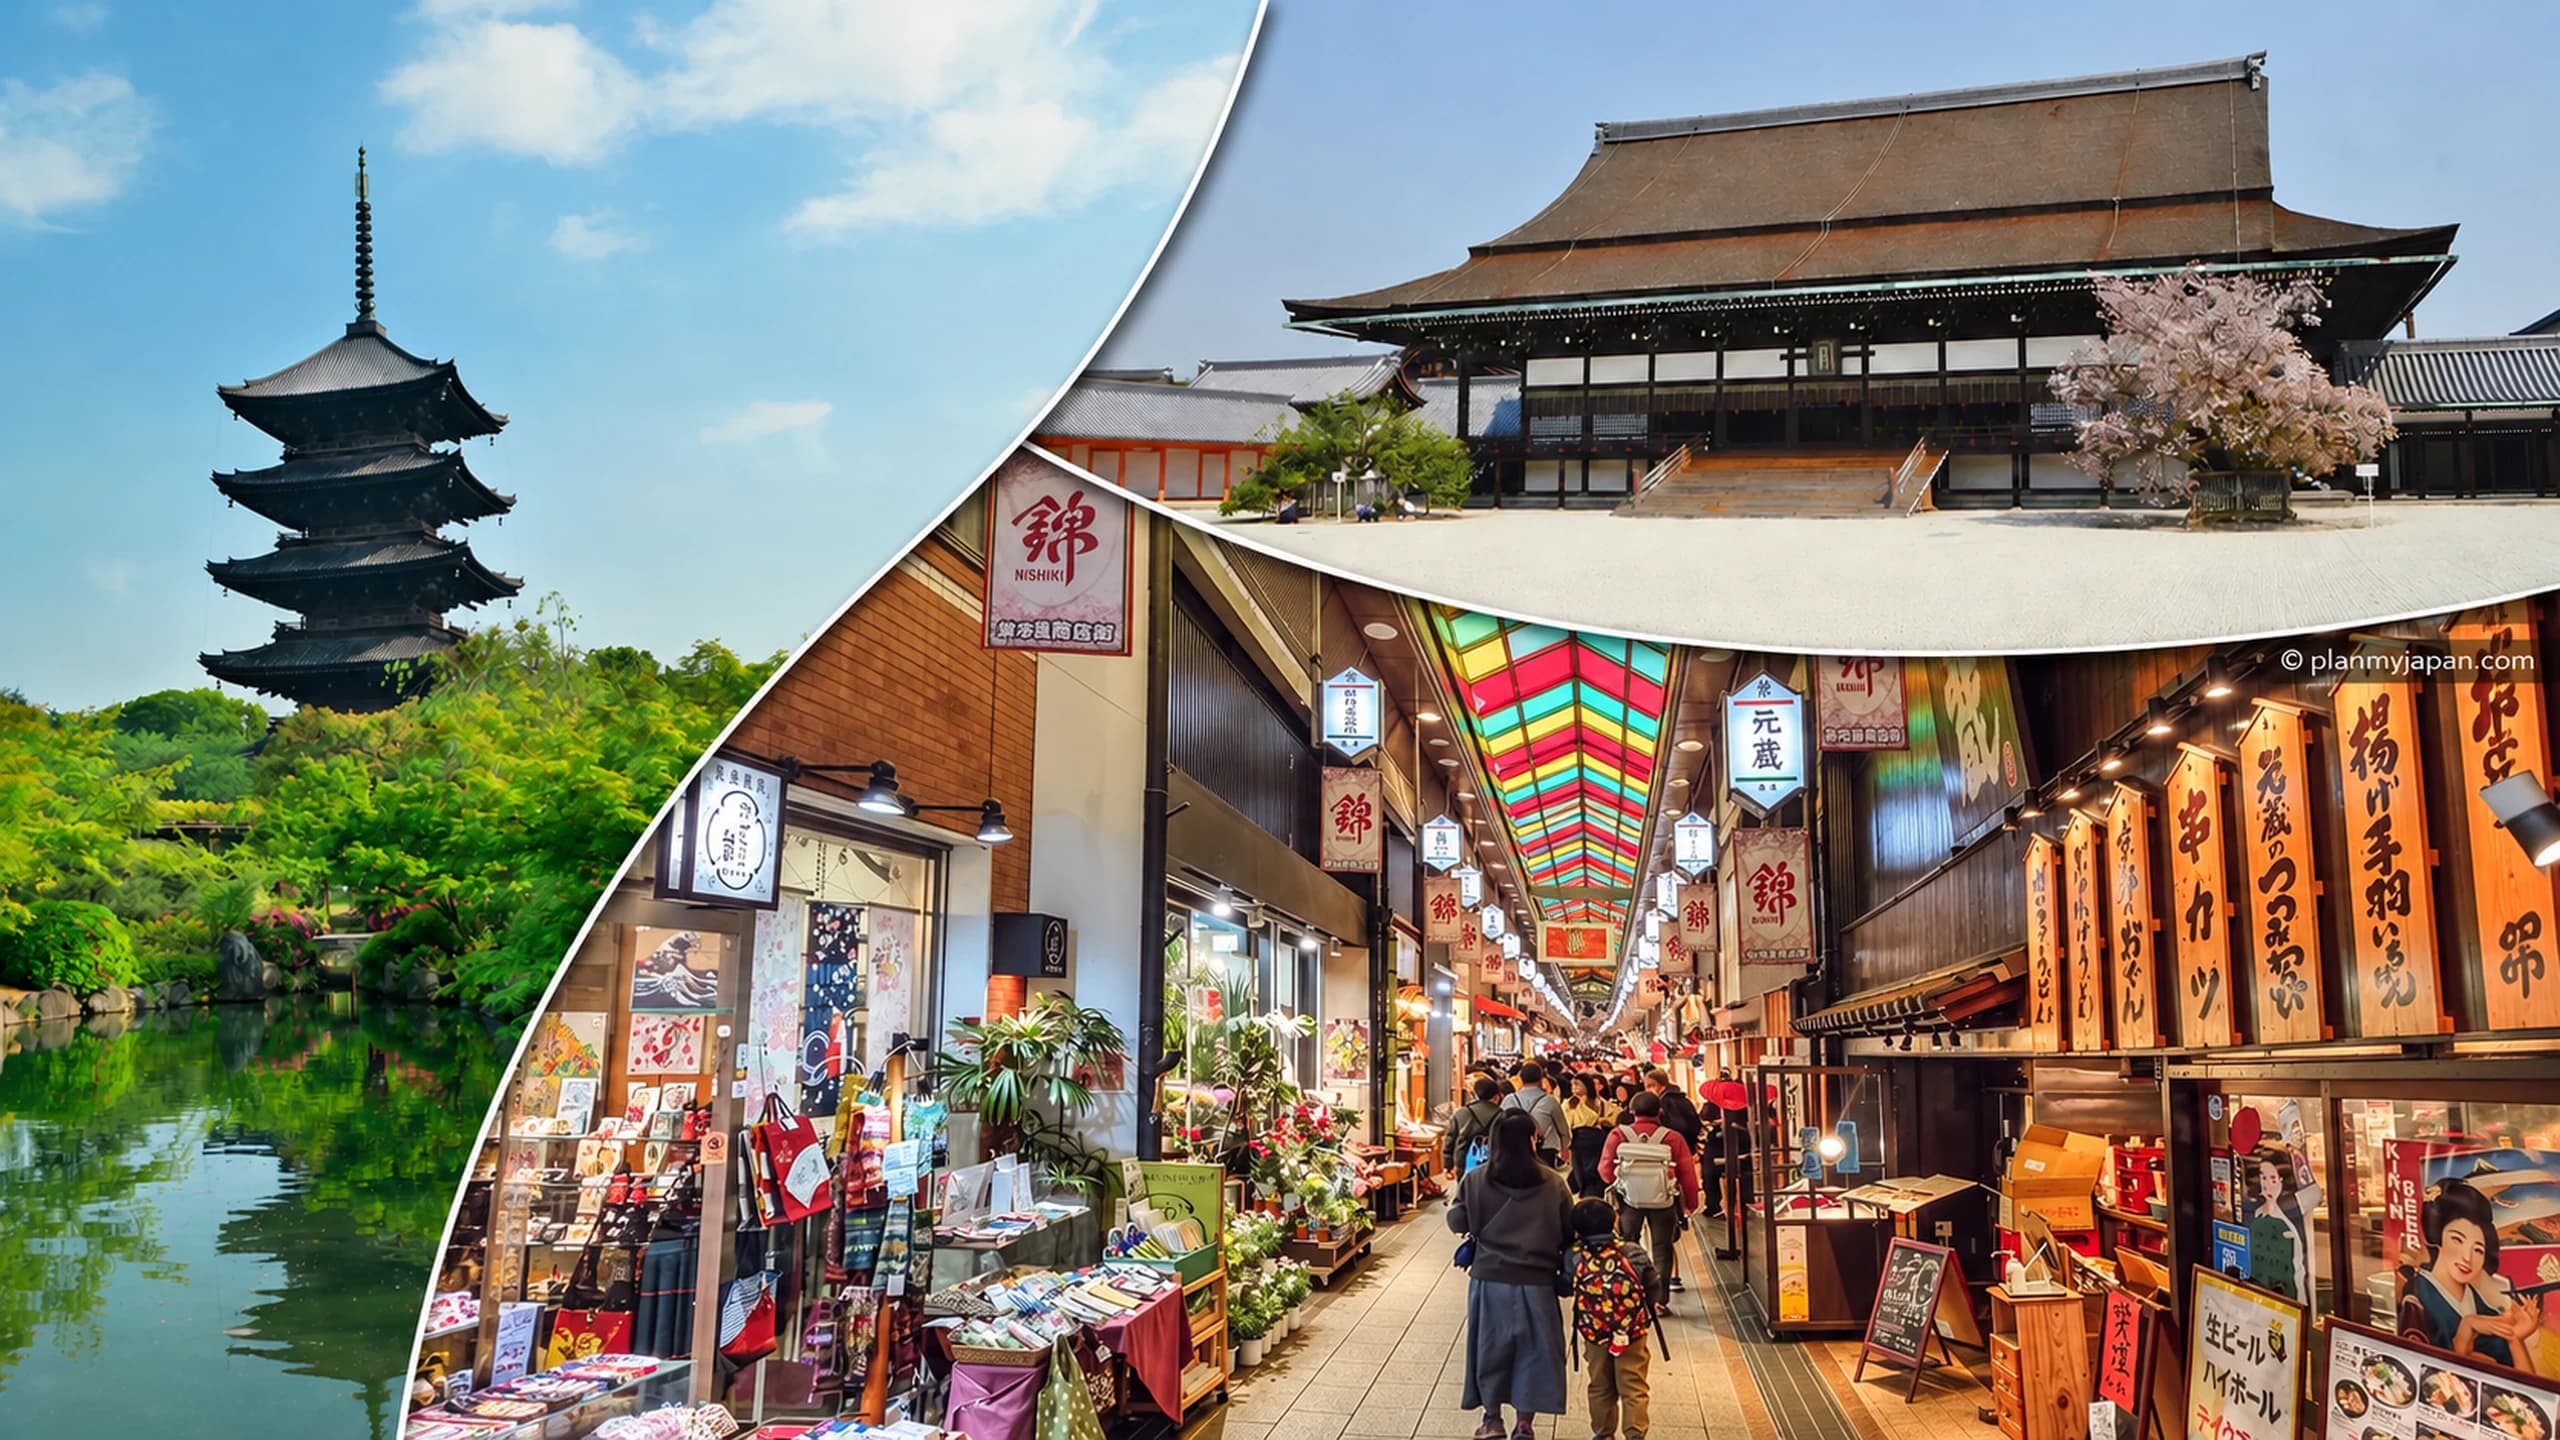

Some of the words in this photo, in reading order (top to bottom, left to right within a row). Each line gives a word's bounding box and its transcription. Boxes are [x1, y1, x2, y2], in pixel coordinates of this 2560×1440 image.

[1011, 489, 1099, 587] 錦
[1014, 568, 1065, 582] NISHIKI
[1751, 708, 1784, 771] 元蔵
[1329, 791, 1374, 846] 錦
[1745, 860, 1798, 929] 錦
[2177, 788, 2220, 1021] 串カツ
[2402, 1180, 2422, 1250] BEER
[2204, 1311, 2267, 1366] 生ビール
[2202, 1359, 2283, 1425] ハイボール
